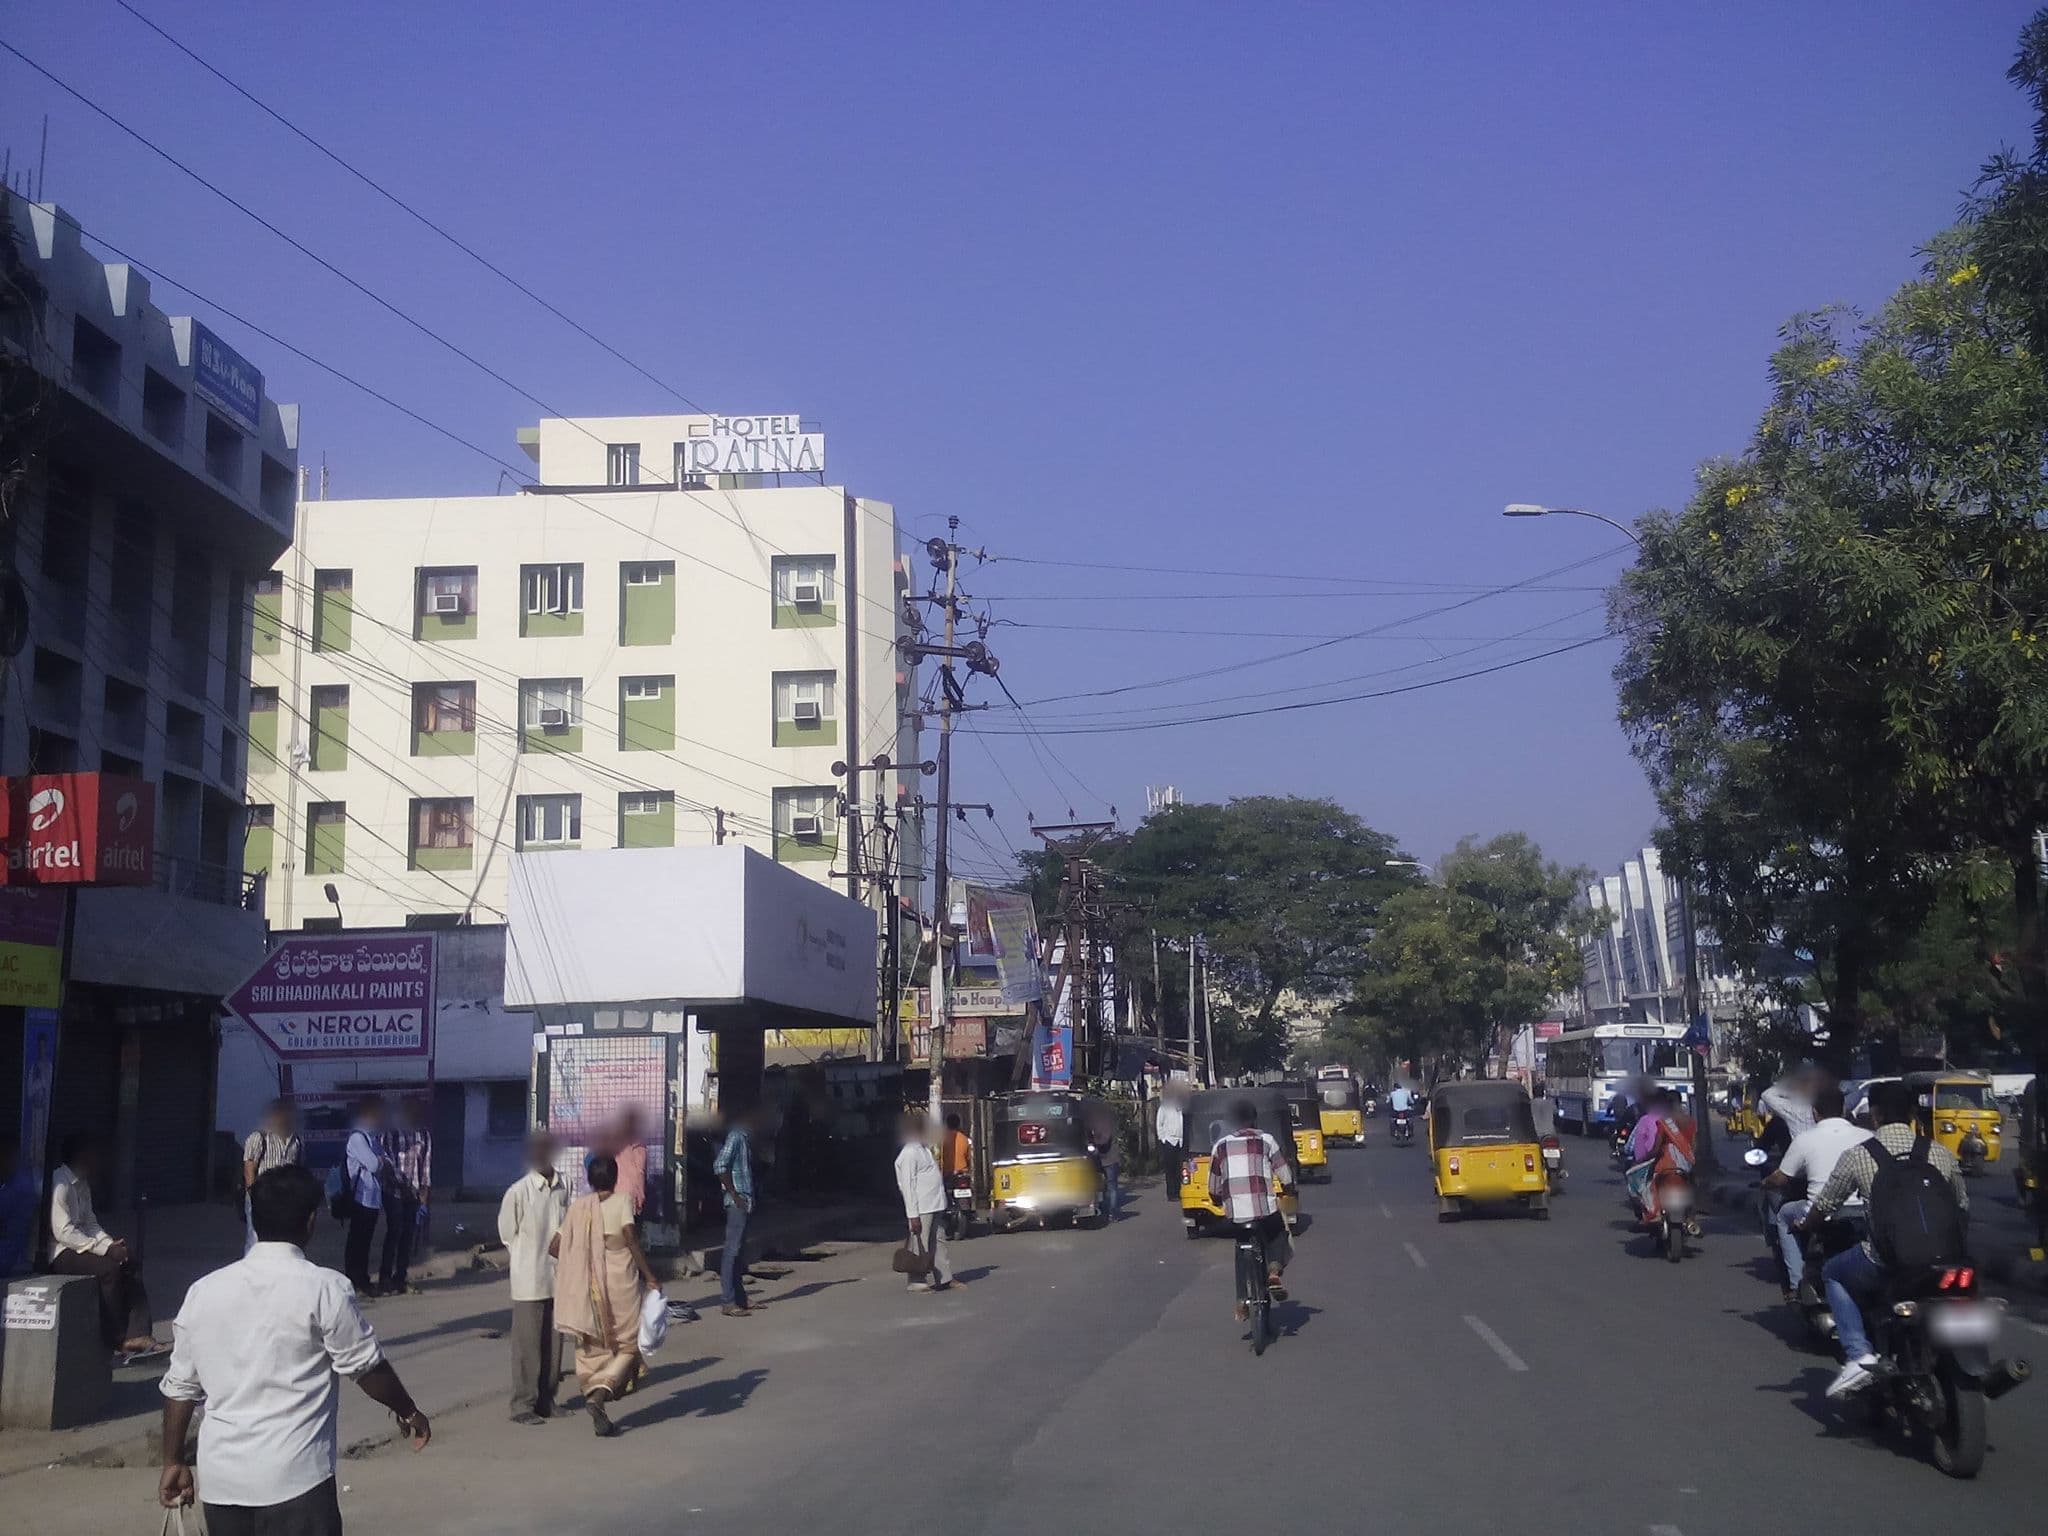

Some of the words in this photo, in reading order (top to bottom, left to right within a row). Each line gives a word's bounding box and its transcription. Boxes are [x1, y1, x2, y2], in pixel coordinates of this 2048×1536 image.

[712, 416, 796, 436] HOTEL
[688, 437, 820, 473] RATNA
[9, 841, 80, 870] airtel
[104, 842, 145, 872] airtel
[251, 985, 273, 1003] SRI
[276, 983, 364, 1002] BHADRAKALI
[369, 981, 424, 999] PAINTS
[307, 1014, 414, 1034] NEROLAC
